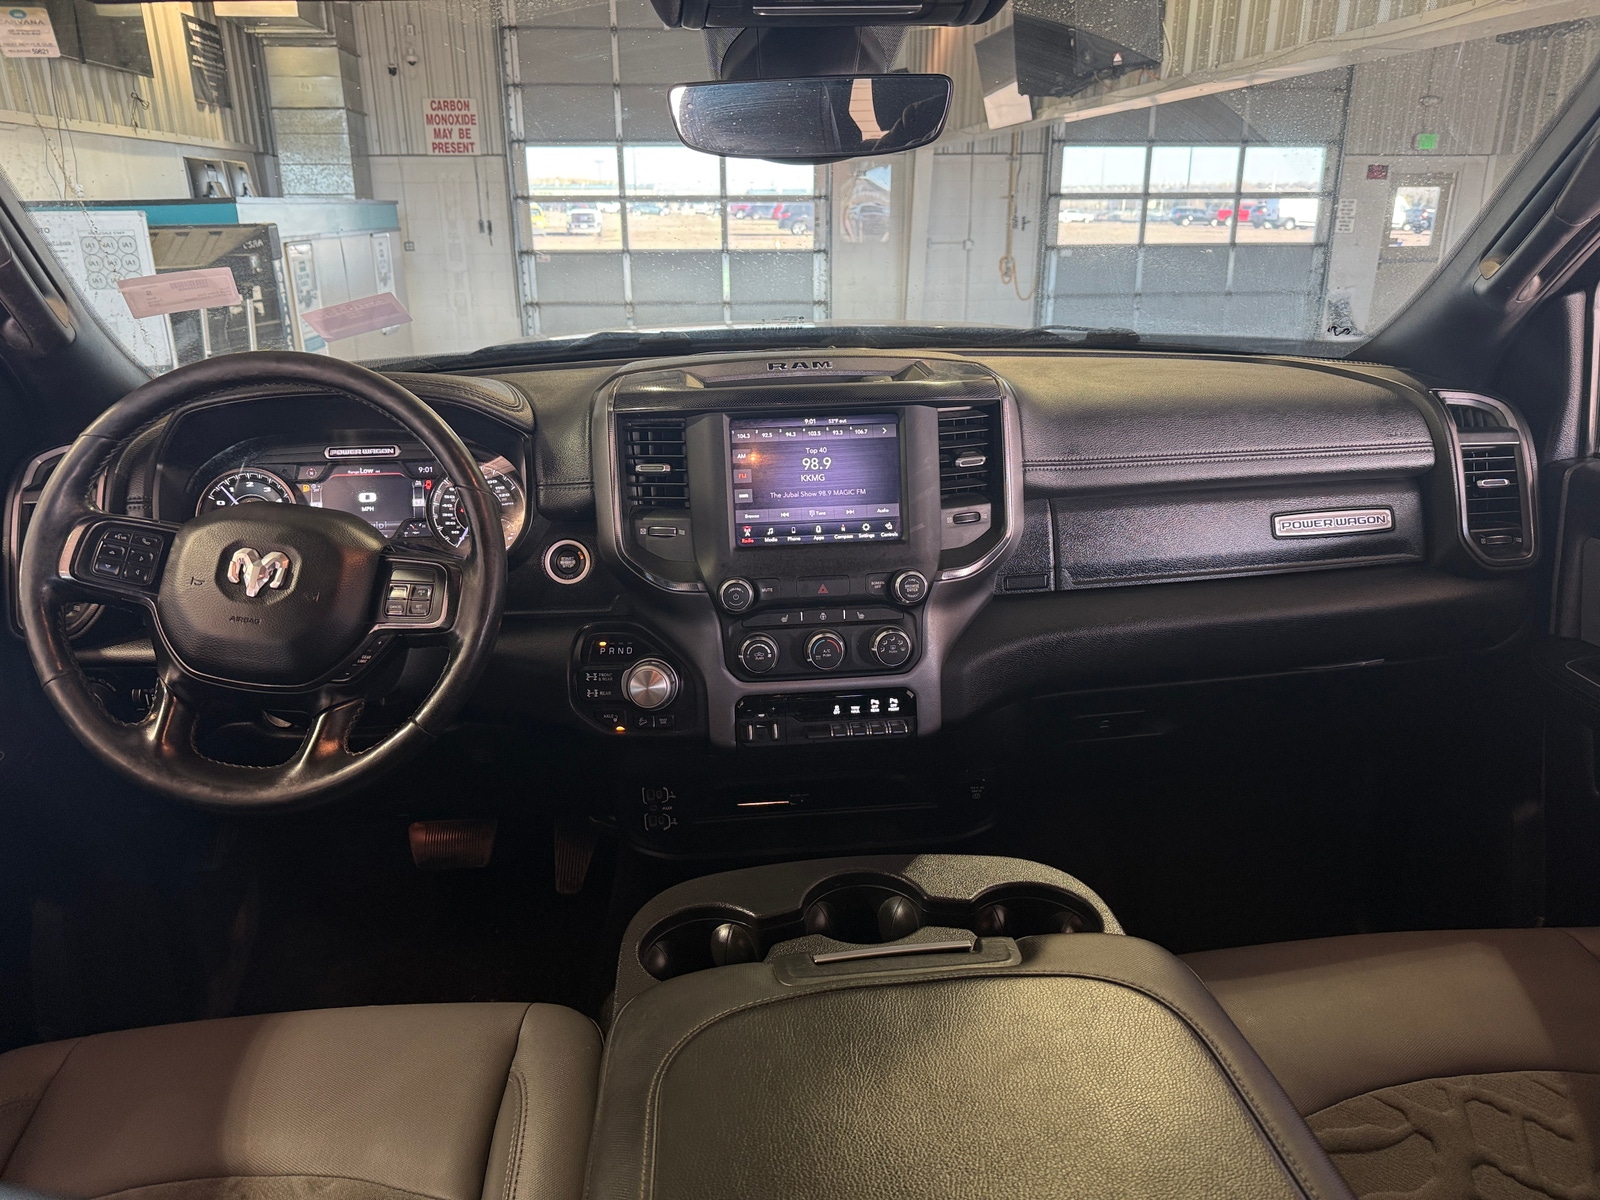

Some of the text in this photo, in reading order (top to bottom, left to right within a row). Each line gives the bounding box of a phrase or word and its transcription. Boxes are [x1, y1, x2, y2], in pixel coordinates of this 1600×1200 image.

[430, 100, 470, 111] CARBON
[426, 114, 476, 126] MONOXIDE
[434, 128, 472, 140] MAY BE
[432, 142, 475, 154] PRESENT
[766, 361, 832, 370] RAM
[802, 457, 832, 470] 98.9
[1281, 515, 1386, 530] POWER WAGON
